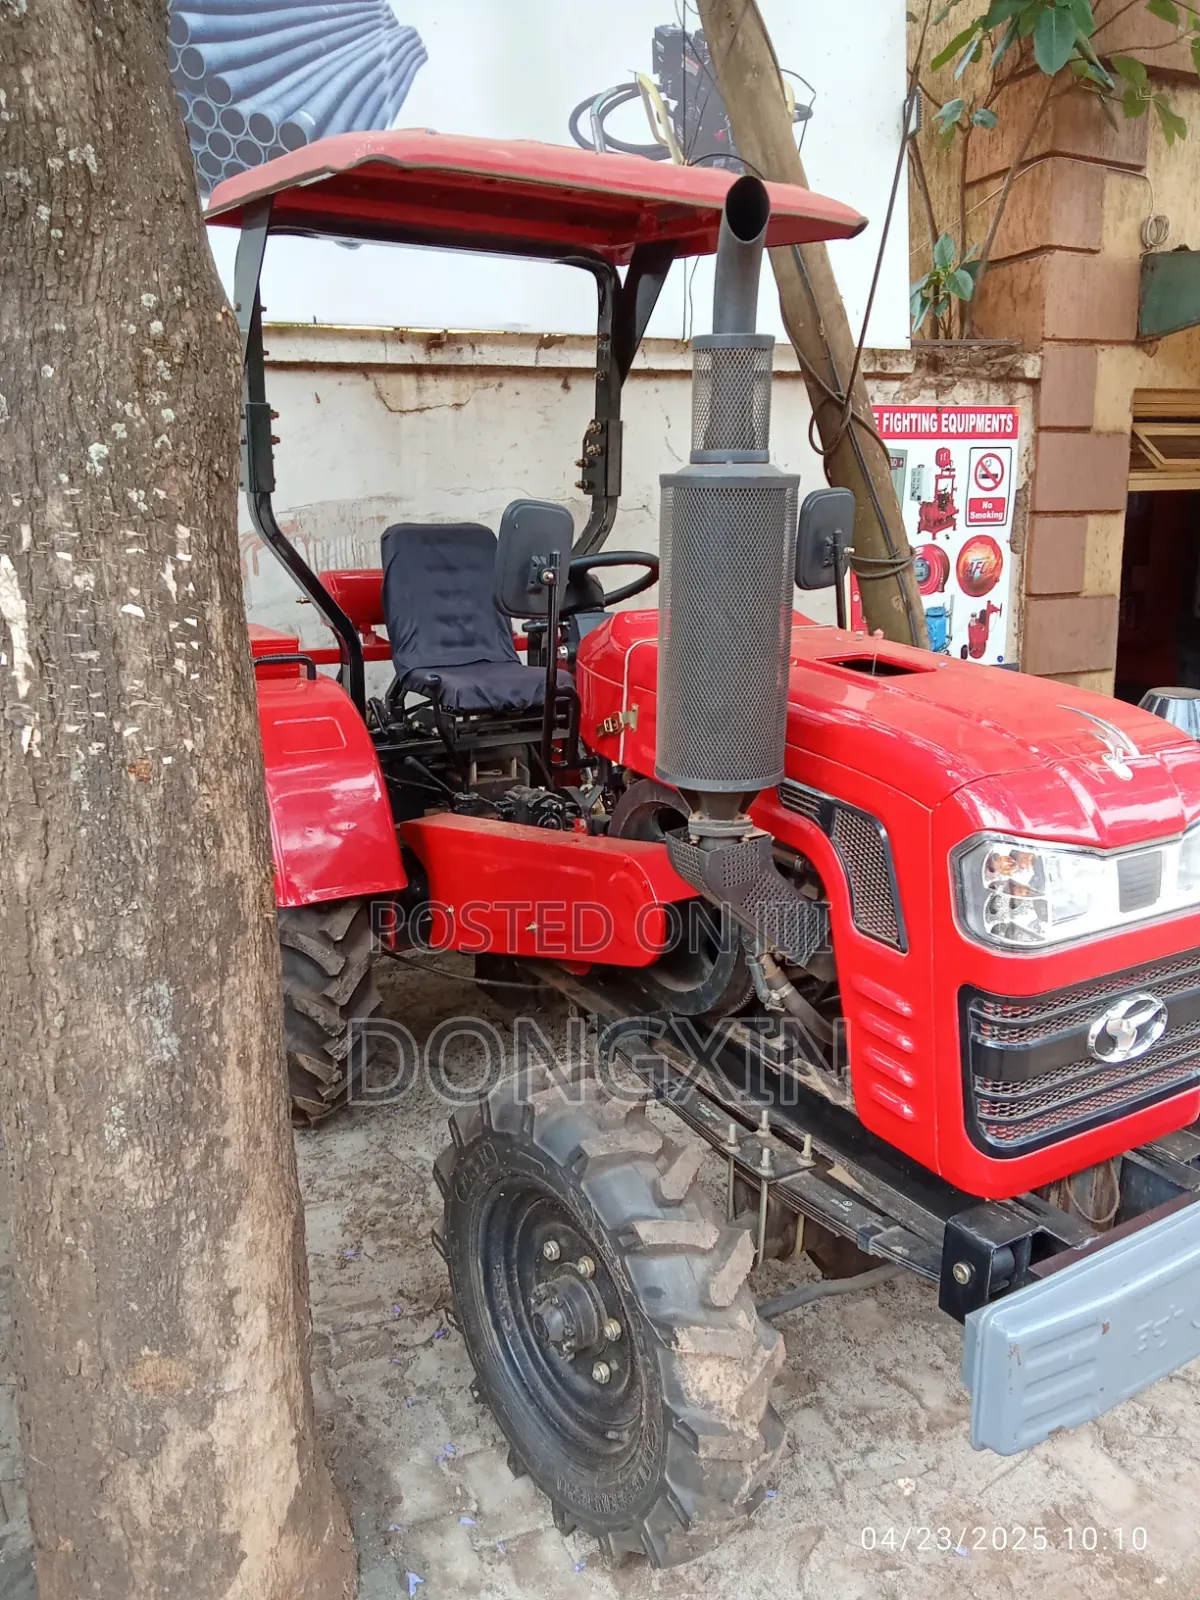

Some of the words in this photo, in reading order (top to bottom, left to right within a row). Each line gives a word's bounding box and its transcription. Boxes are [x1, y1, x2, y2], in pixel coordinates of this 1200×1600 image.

[882, 412, 938, 433] FIGHTING
[941, 412, 1013, 434] EQUIPMENTS
[982, 500, 993, 509] No
[970, 510, 1003, 520] Smoking
